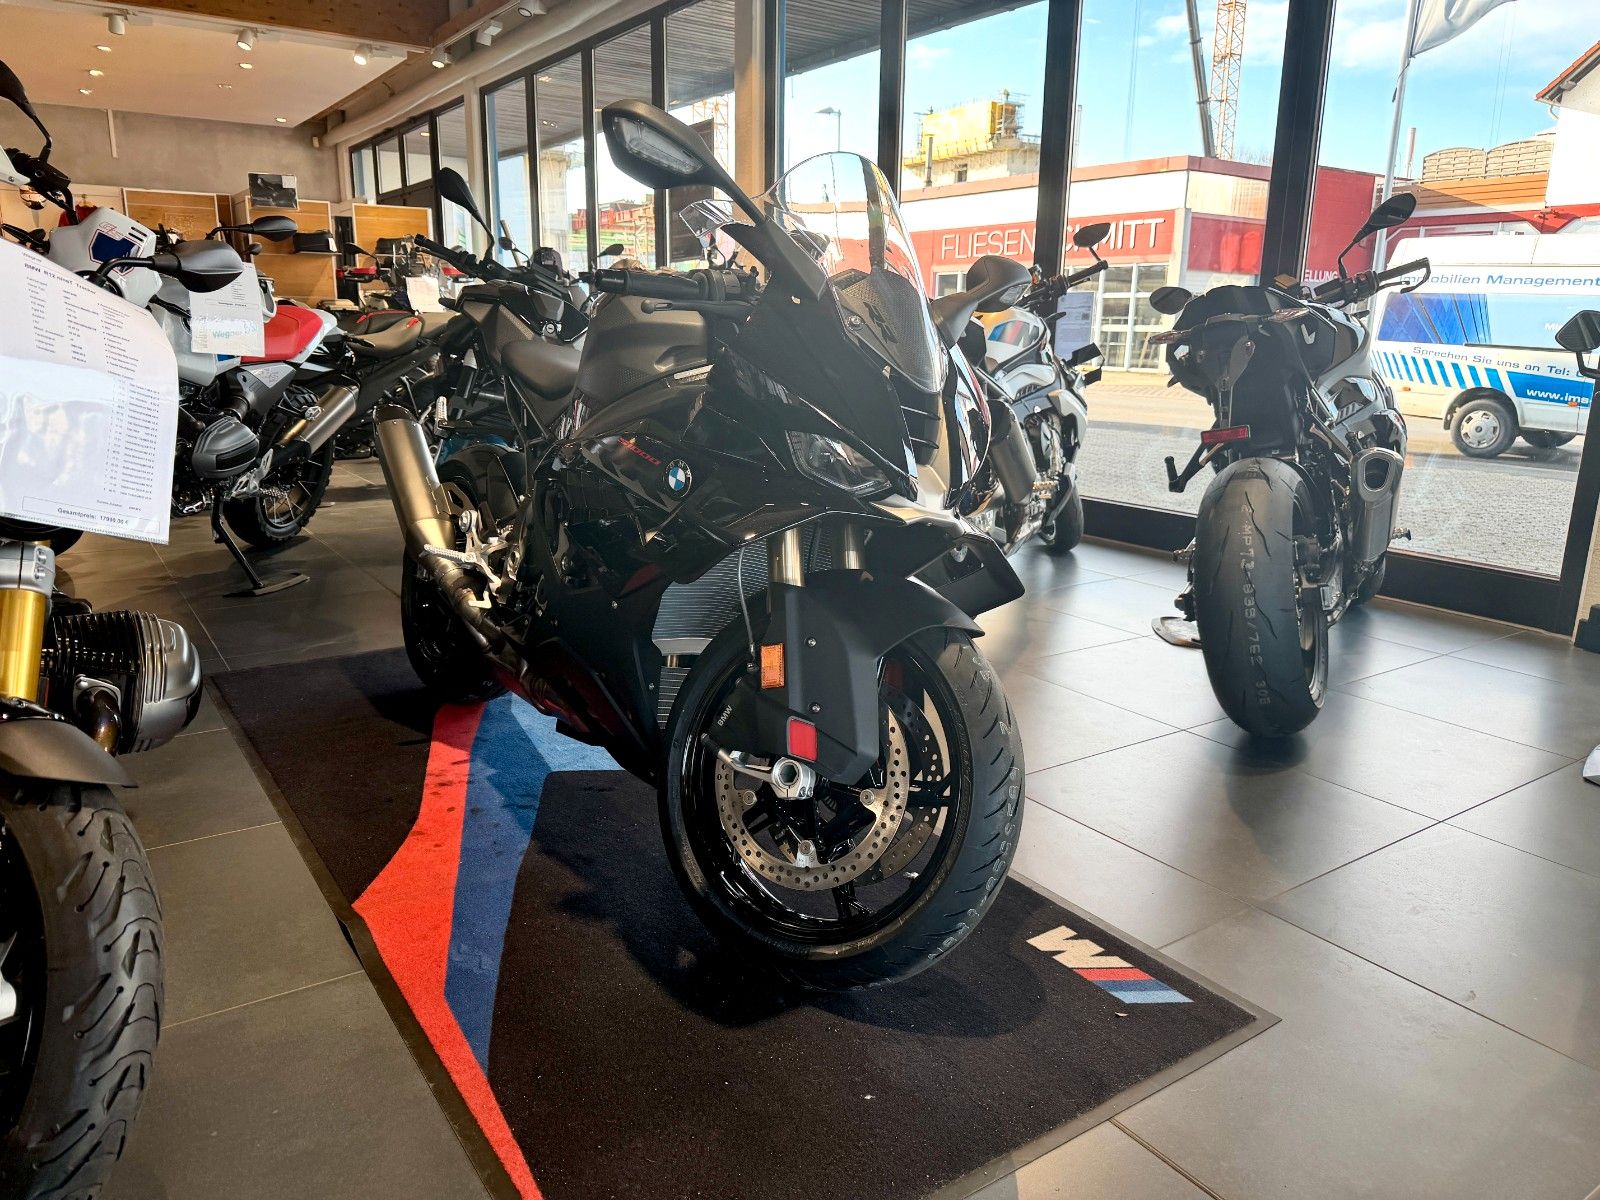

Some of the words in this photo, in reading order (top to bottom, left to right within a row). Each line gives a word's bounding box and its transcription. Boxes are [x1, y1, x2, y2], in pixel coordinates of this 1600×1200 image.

[941, 229, 1036, 260] FLIESEN
[1486, 274, 1600, 287] Management
[1413, 346, 1468, 361] Sprechen
[1473, 355, 1492, 365] Sie
[1497, 360, 1520, 369] uns
[1524, 364, 1540, 372] an
[1547, 365, 1570, 376] Tel:
[717, 705, 732, 727] BMW
